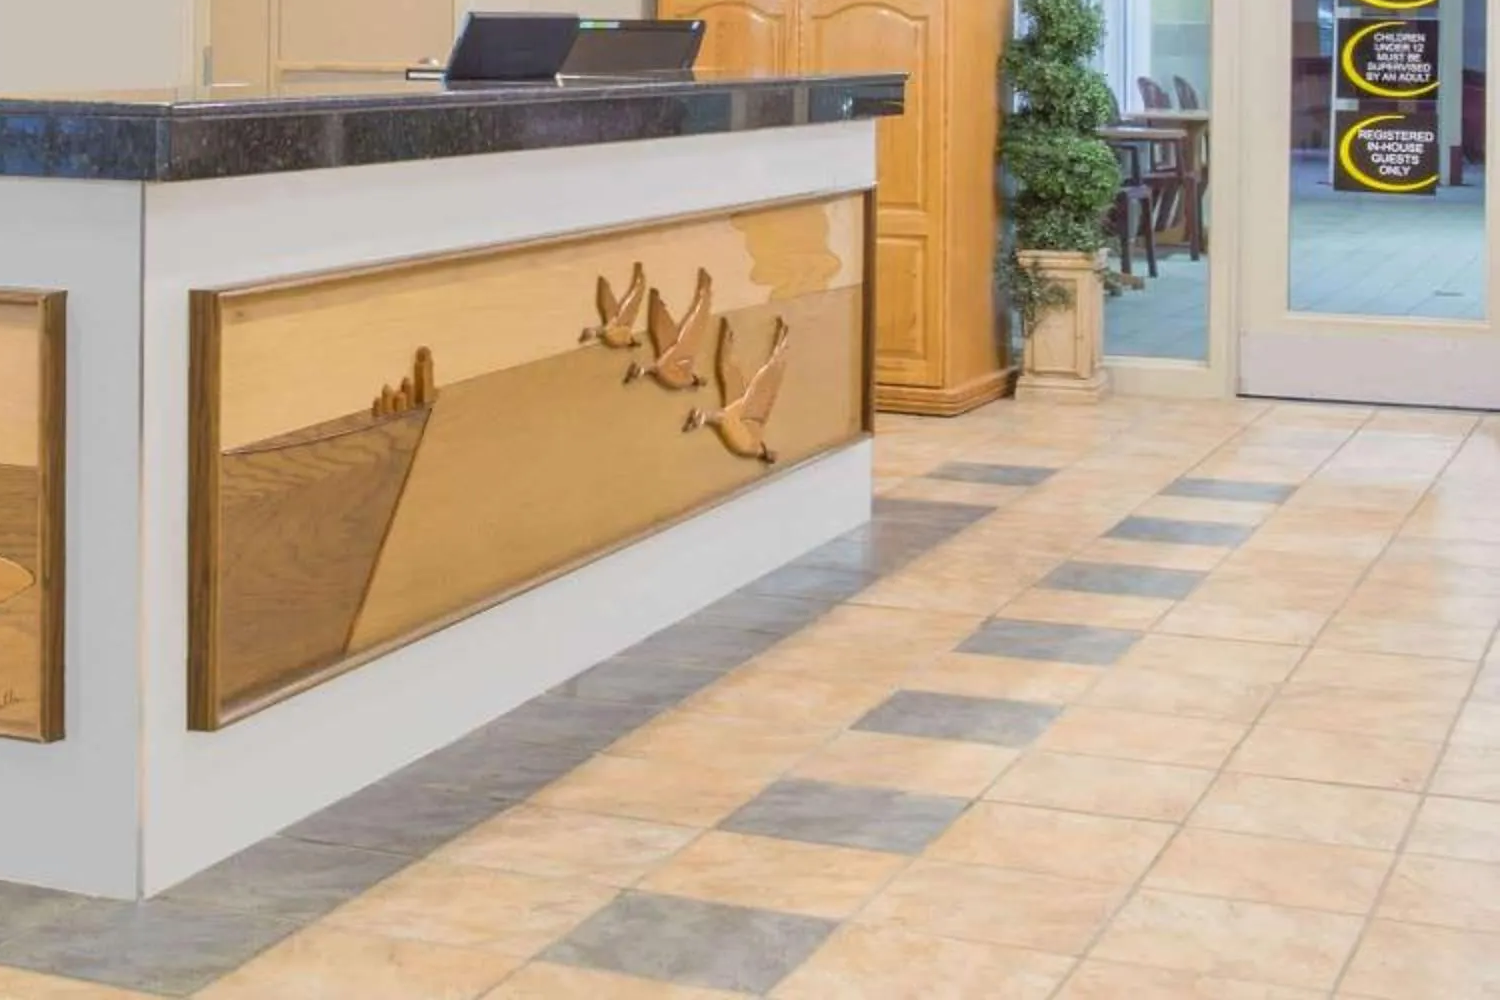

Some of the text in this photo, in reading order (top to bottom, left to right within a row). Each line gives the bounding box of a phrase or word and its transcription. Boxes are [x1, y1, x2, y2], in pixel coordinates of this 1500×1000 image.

[1374, 32, 1426, 42] CHILDREN
[1374, 43, 1411, 52] UNDER
[1376, 53, 1405, 61] MUST
[1367, 62, 1432, 73] SUPERVISED
[1366, 72, 1431, 83] BY AN ADULT
[1358, 129, 1434, 142] REGISTERED
[1367, 141, 1425, 154] IN-HOUSE
[1371, 154, 1420, 165] GUESTS
[1380, 165, 1411, 176] ONLY
